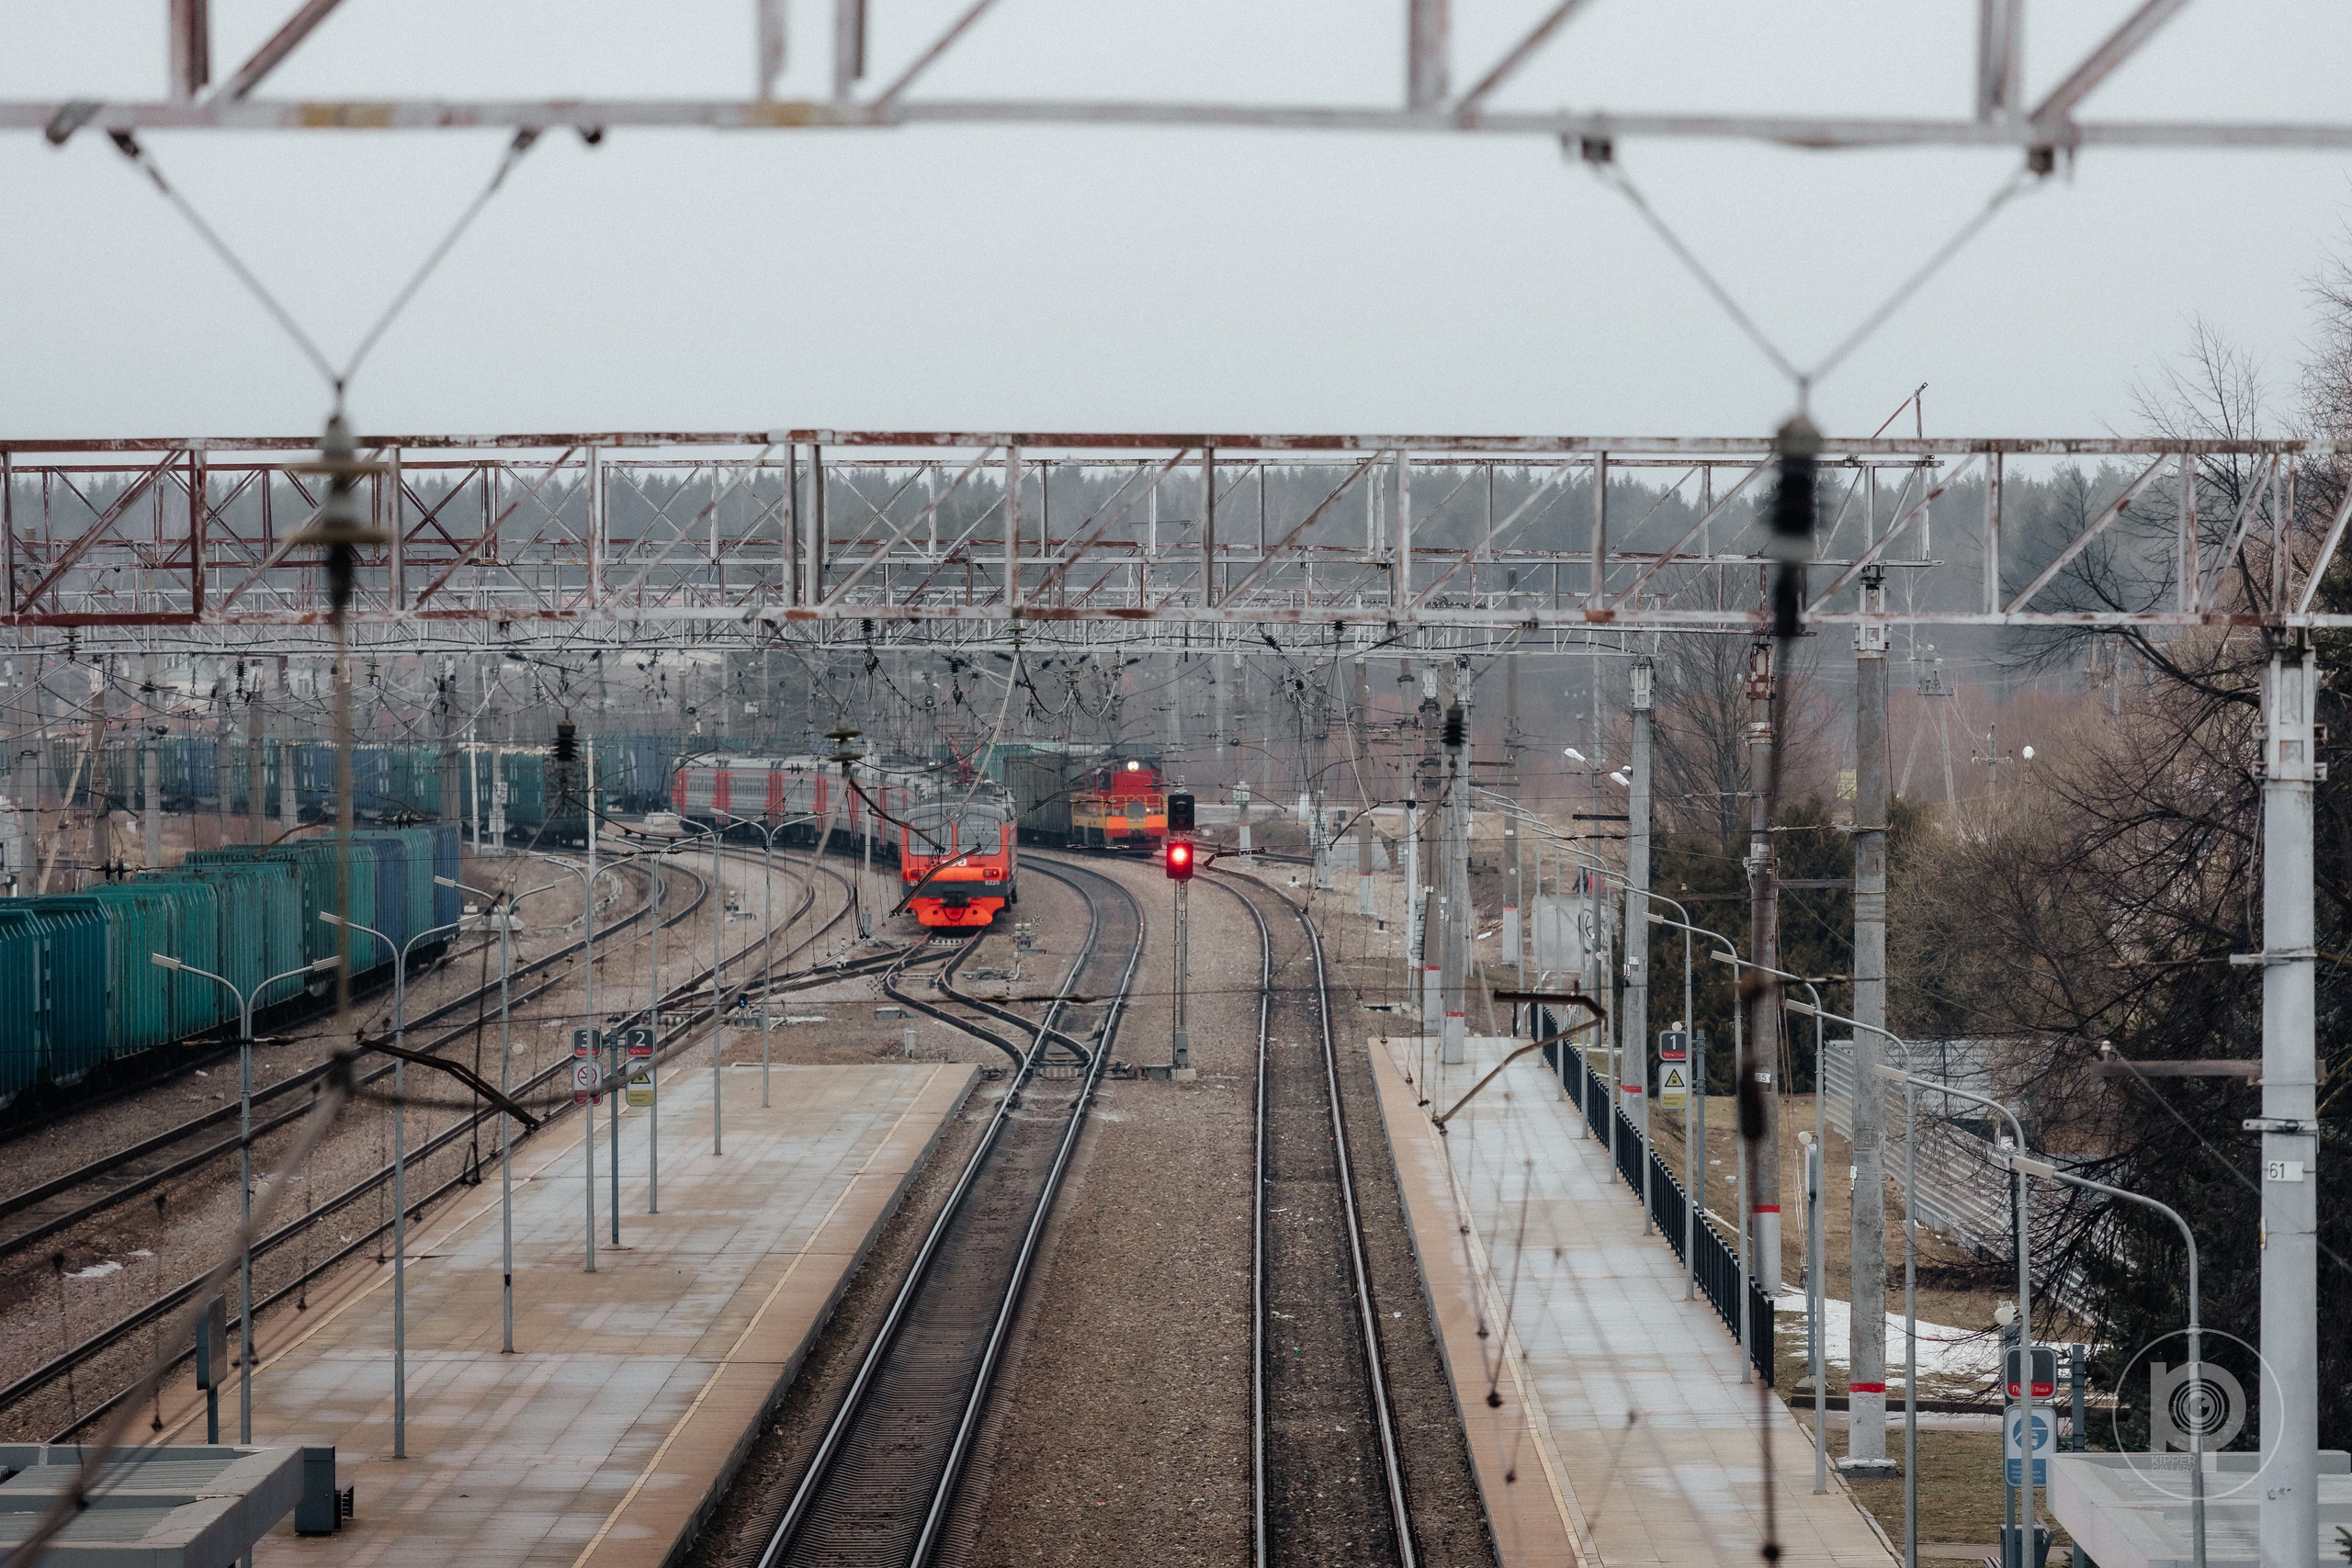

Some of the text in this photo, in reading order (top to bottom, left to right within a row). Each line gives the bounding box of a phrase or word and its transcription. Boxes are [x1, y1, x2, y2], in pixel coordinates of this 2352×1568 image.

[635, 1031, 646, 1047] 2
[1669, 1034, 1677, 1050] 1
[1757, 1073, 1767, 1082] 65
[2269, 1162, 2285, 1179] 61
